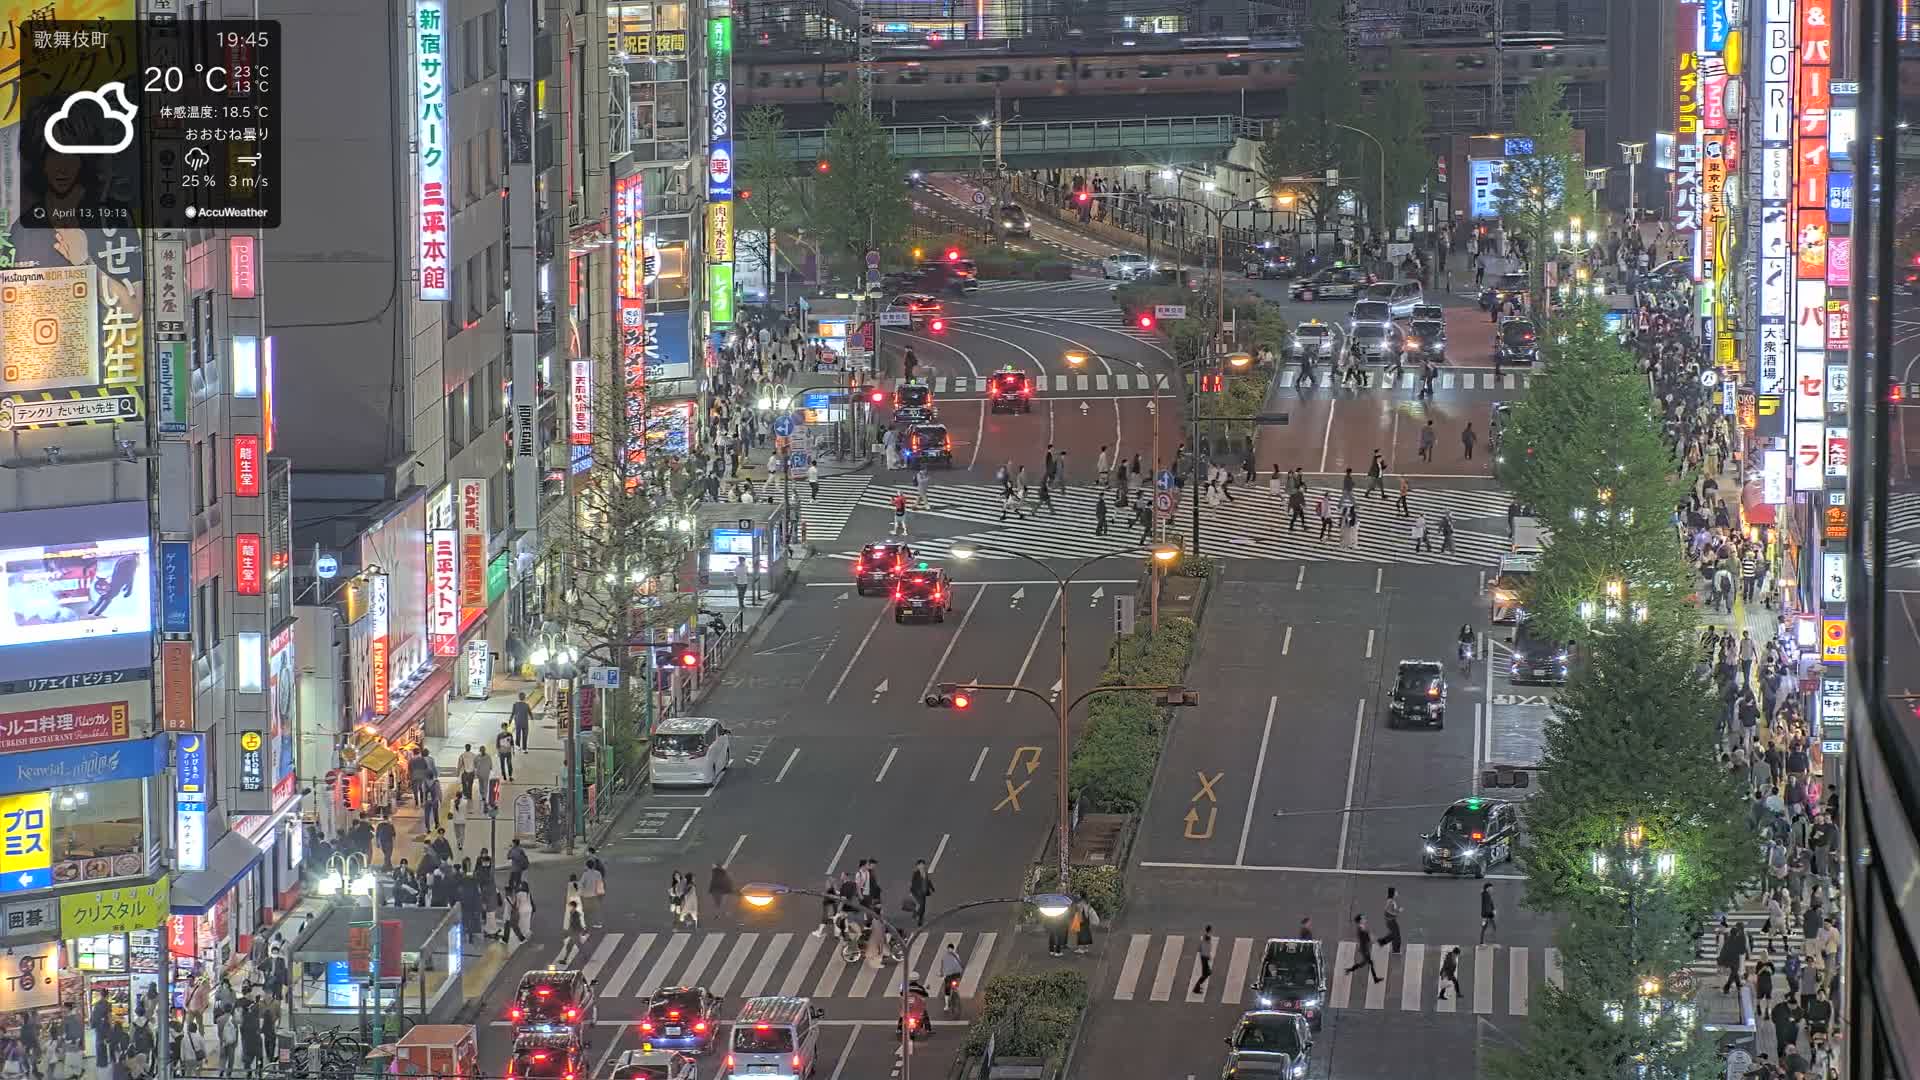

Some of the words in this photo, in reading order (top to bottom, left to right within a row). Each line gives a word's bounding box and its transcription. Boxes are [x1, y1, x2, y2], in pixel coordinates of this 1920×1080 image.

[624, 35, 650, 54] 祝日
[656, 34, 685, 52] 夜間
[420, 9, 443, 167] 新宿サンパーク
[1680, 51, 1697, 133] パチンコ
[1801, 39, 1830, 202] パーティー
[1676, 144, 1697, 230] エスパス
[423, 182, 445, 289] 三平本館
[162, 322, 179, 332] 3F
[1763, 327, 1777, 380] 大衆酒場
[161, 351, 173, 413] FamilyMart
[1799, 306, 1824, 466] パセラ
[17, 407, 53, 418] テンクリ
[57, 401, 117, 417] たいせい先生
[465, 484, 476, 529] GAME
[1831, 495, 1844, 504] 3F
[437, 540, 454, 627] 三平ストア
[114, 709, 123, 733] 5F
[169, 719, 186, 729] B2
[29, 732, 73, 745] RESTAURANT
[185, 803, 198, 811] 2F
[4, 808, 43, 833] プロ
[5, 833, 44, 856] ミス
[9, 908, 43, 929] 囲碁
[73, 900, 146, 925] クリスタル
